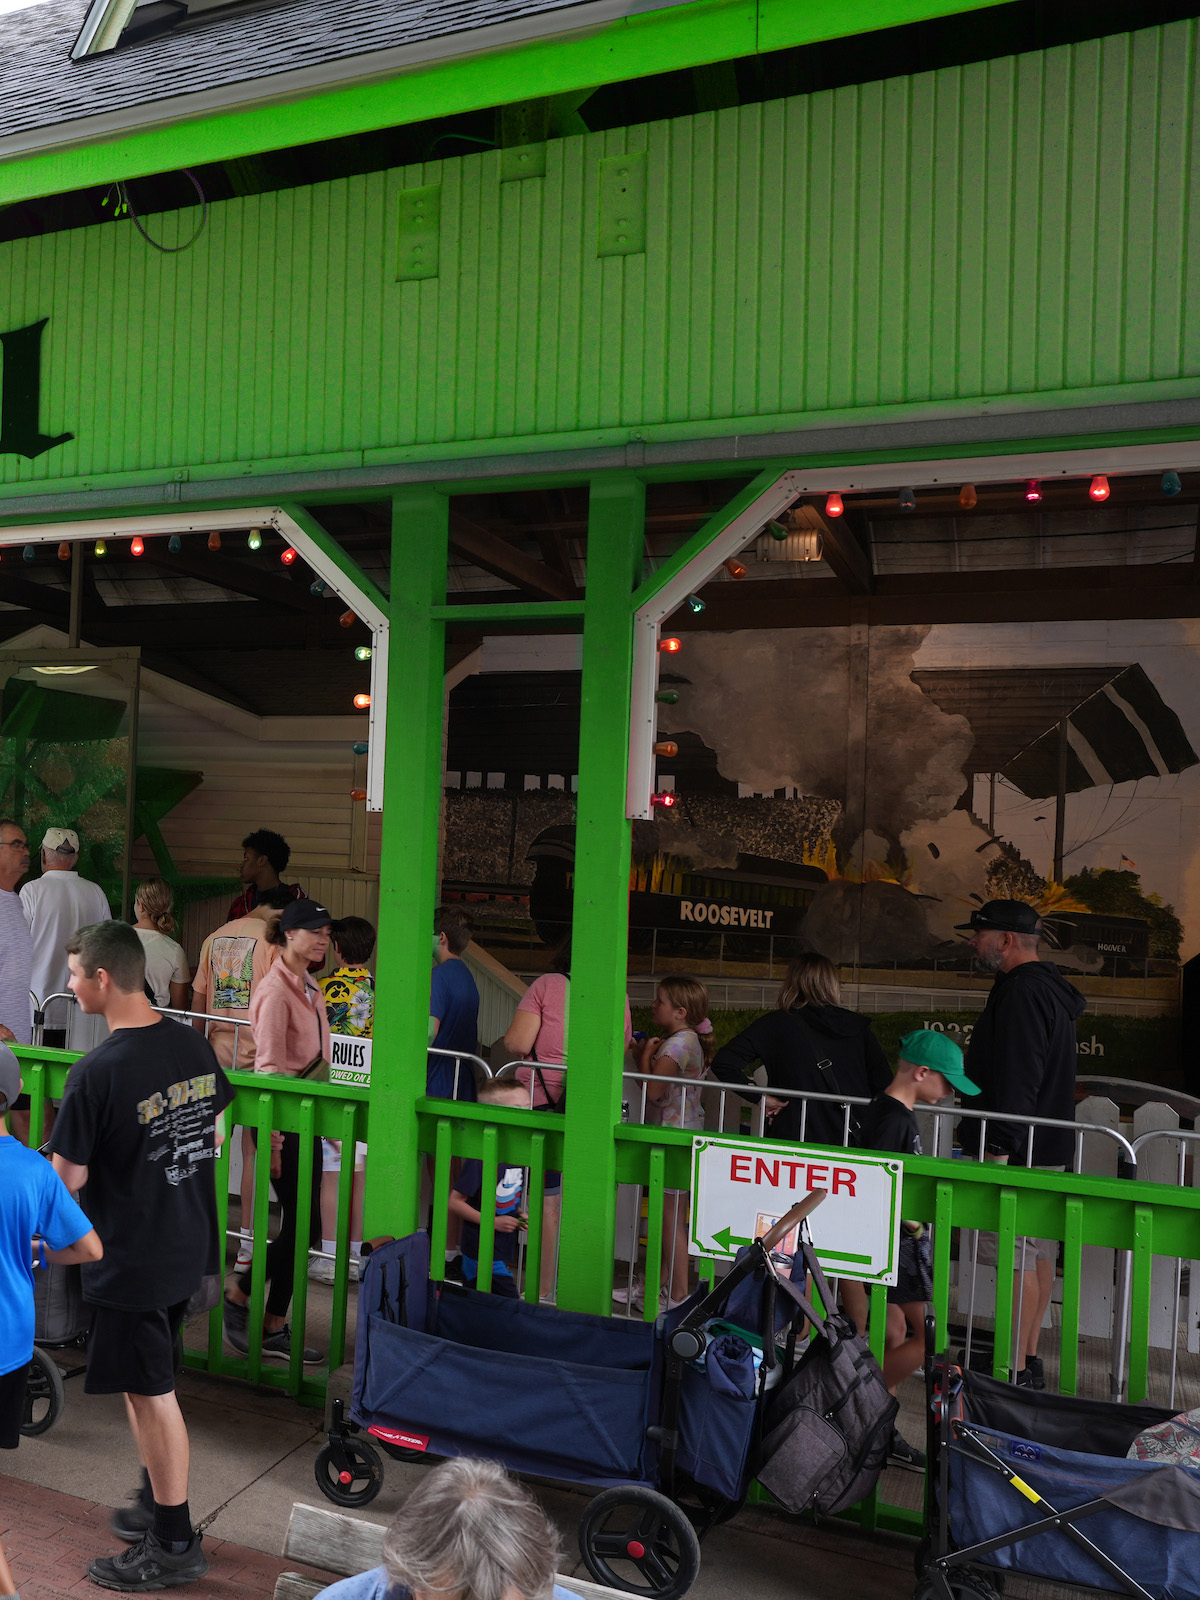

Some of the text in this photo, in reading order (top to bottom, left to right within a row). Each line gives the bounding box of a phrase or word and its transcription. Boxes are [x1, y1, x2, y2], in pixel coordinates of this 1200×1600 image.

[680, 900, 774, 928] ROOSEVELT
[1097, 942, 1127, 953] HOOVER
[332, 1041, 365, 1068] RULES
[353, 1073, 366, 1084] ON
[730, 1154, 857, 1197] ENTER
